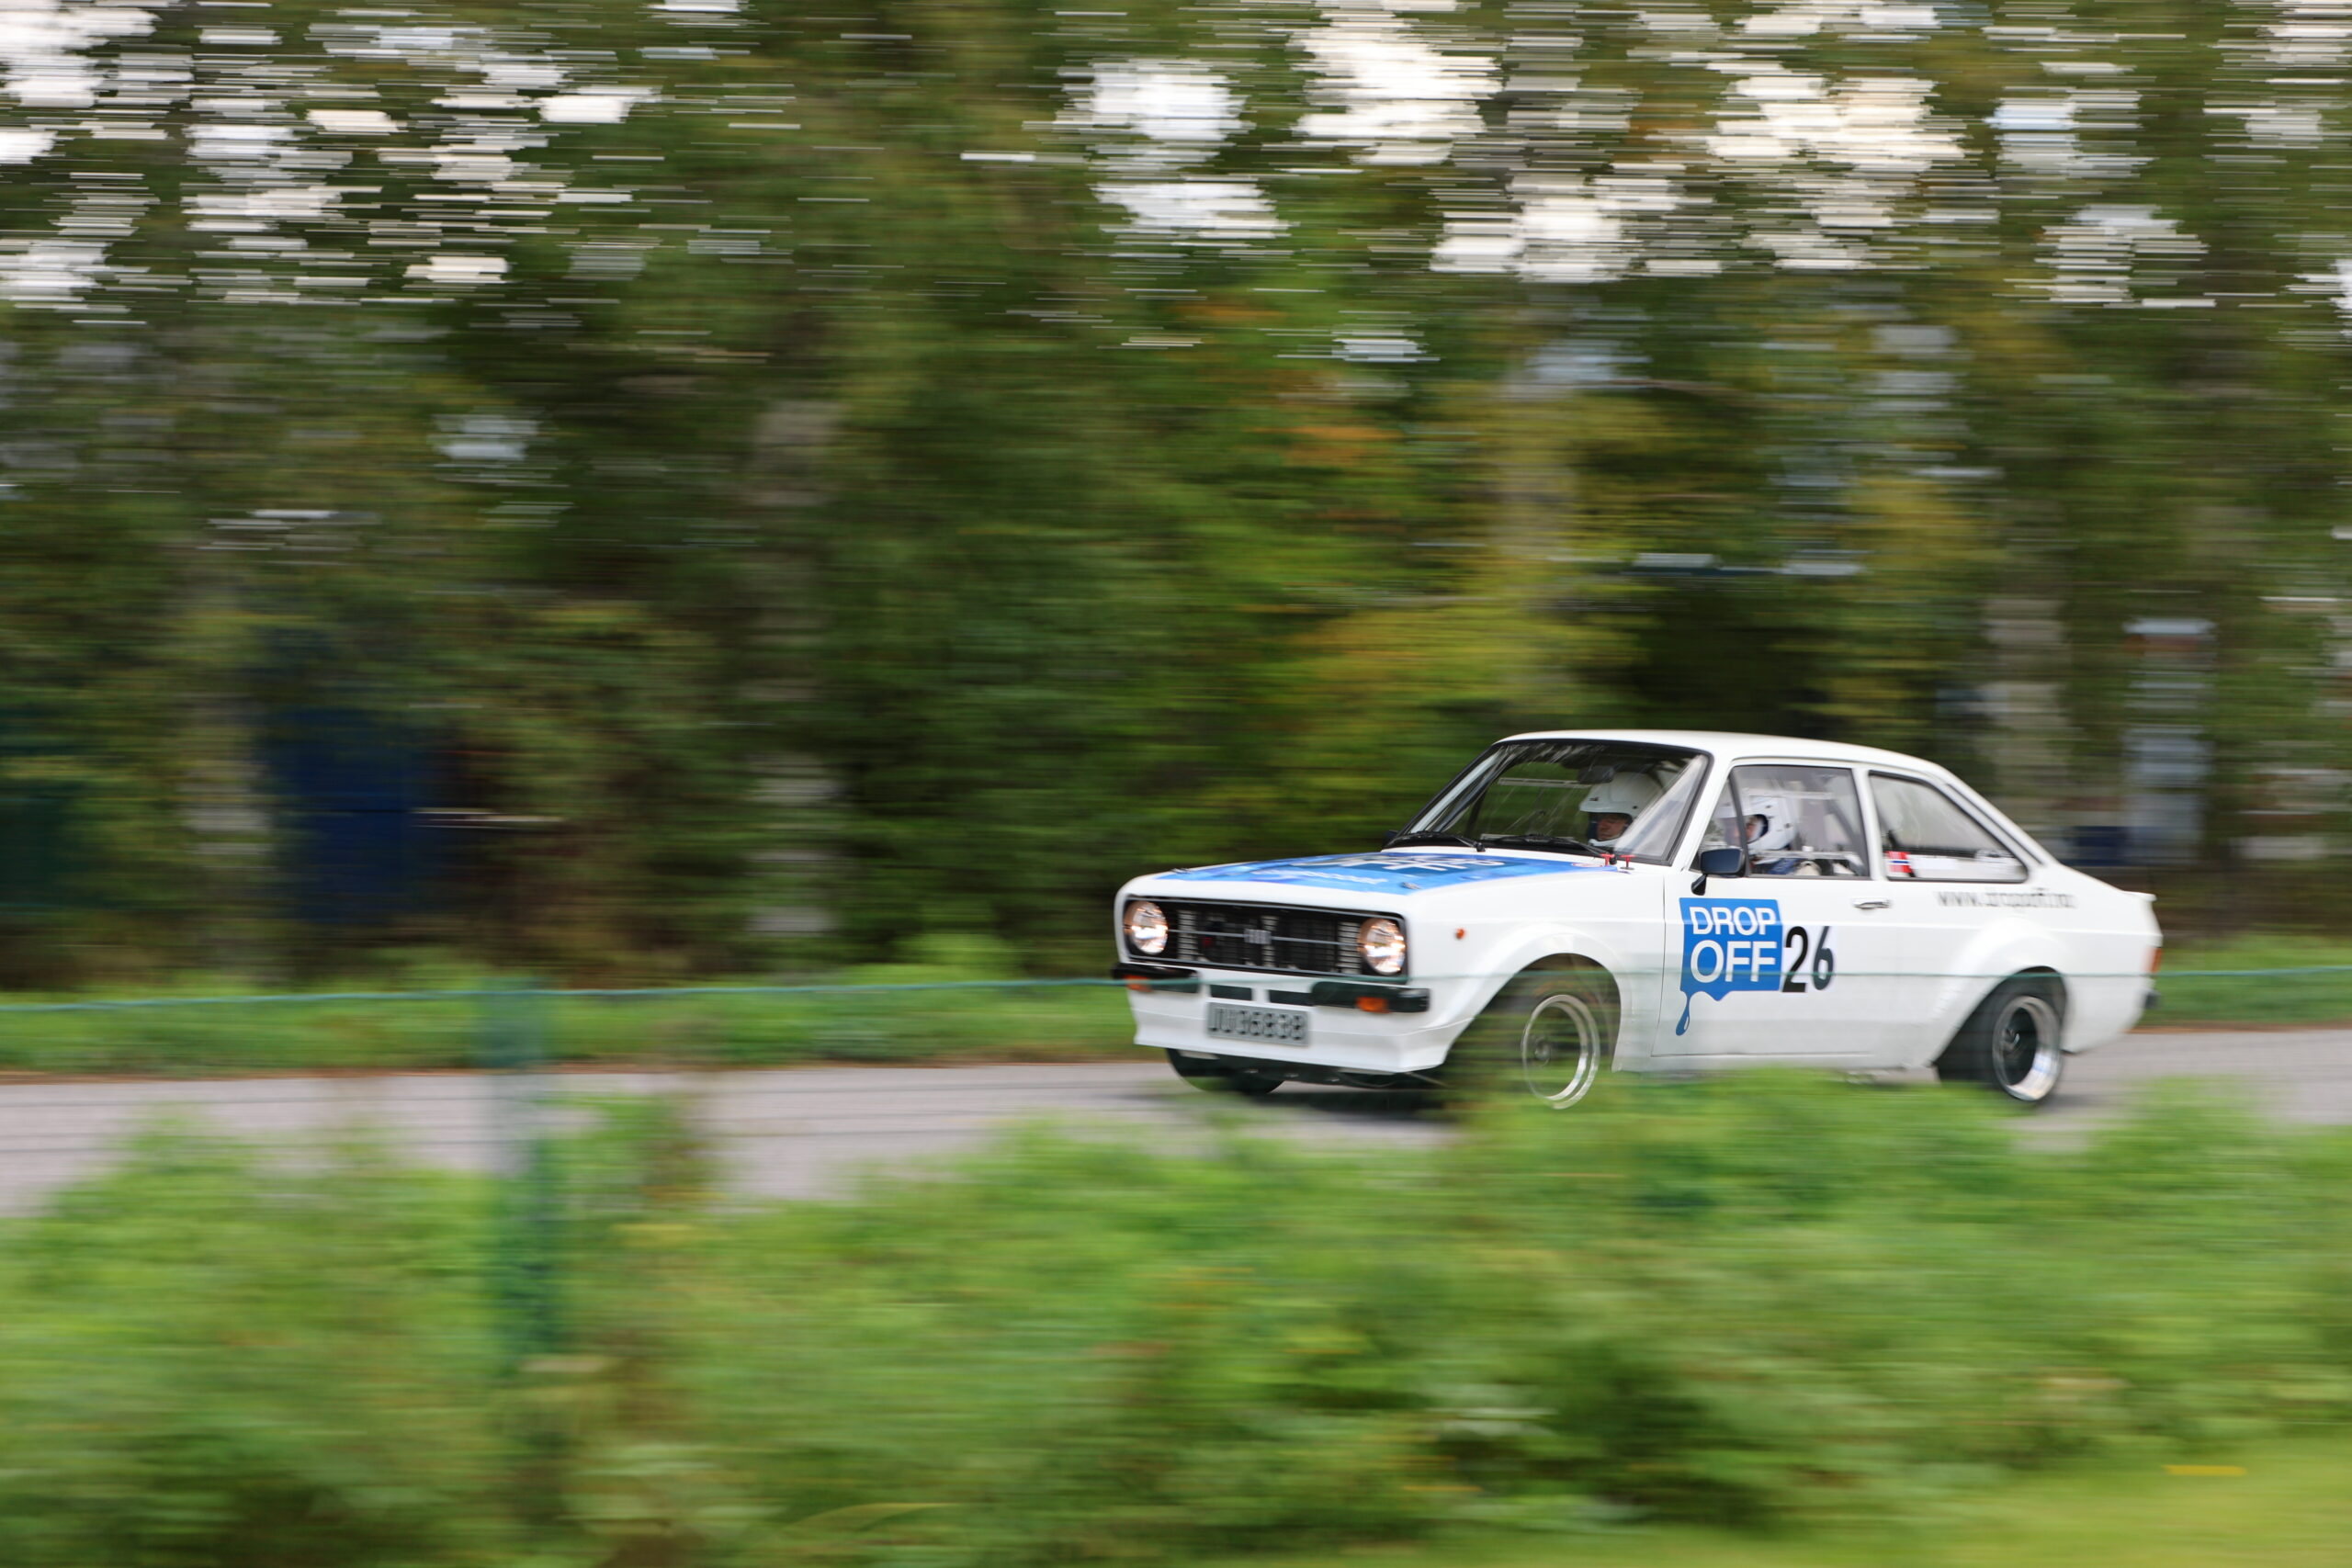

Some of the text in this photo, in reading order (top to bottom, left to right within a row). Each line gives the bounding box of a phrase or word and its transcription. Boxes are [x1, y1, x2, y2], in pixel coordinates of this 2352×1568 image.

[1689, 906, 1778, 936] DROP
[1690, 939, 1778, 984] OFF
[1781, 925, 1834, 993] 26
